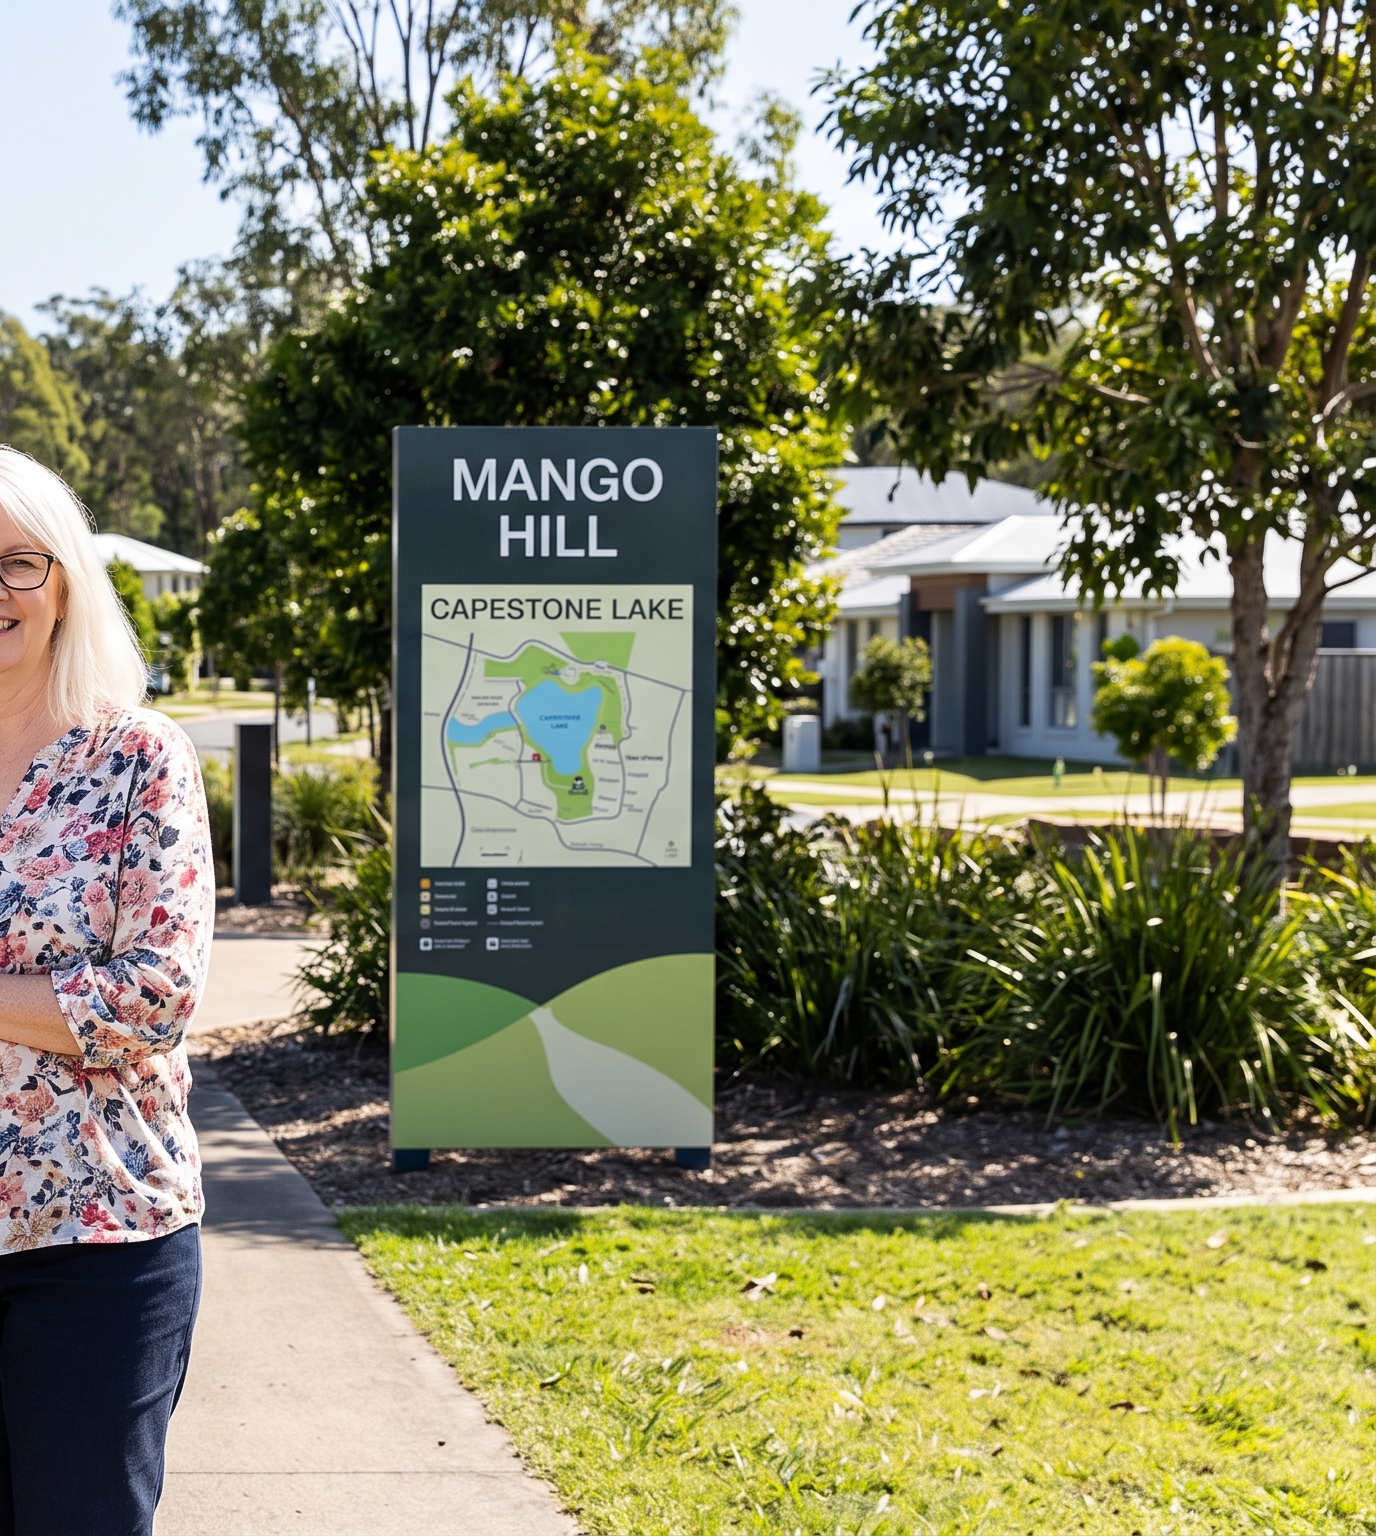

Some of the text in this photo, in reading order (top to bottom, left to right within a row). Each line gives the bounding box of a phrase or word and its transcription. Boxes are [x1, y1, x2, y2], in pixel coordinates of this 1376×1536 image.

[453, 457, 664, 502] MANGO
[499, 514, 618, 557] HILL
[430, 598, 684, 620] CAPESTONE LAKE
